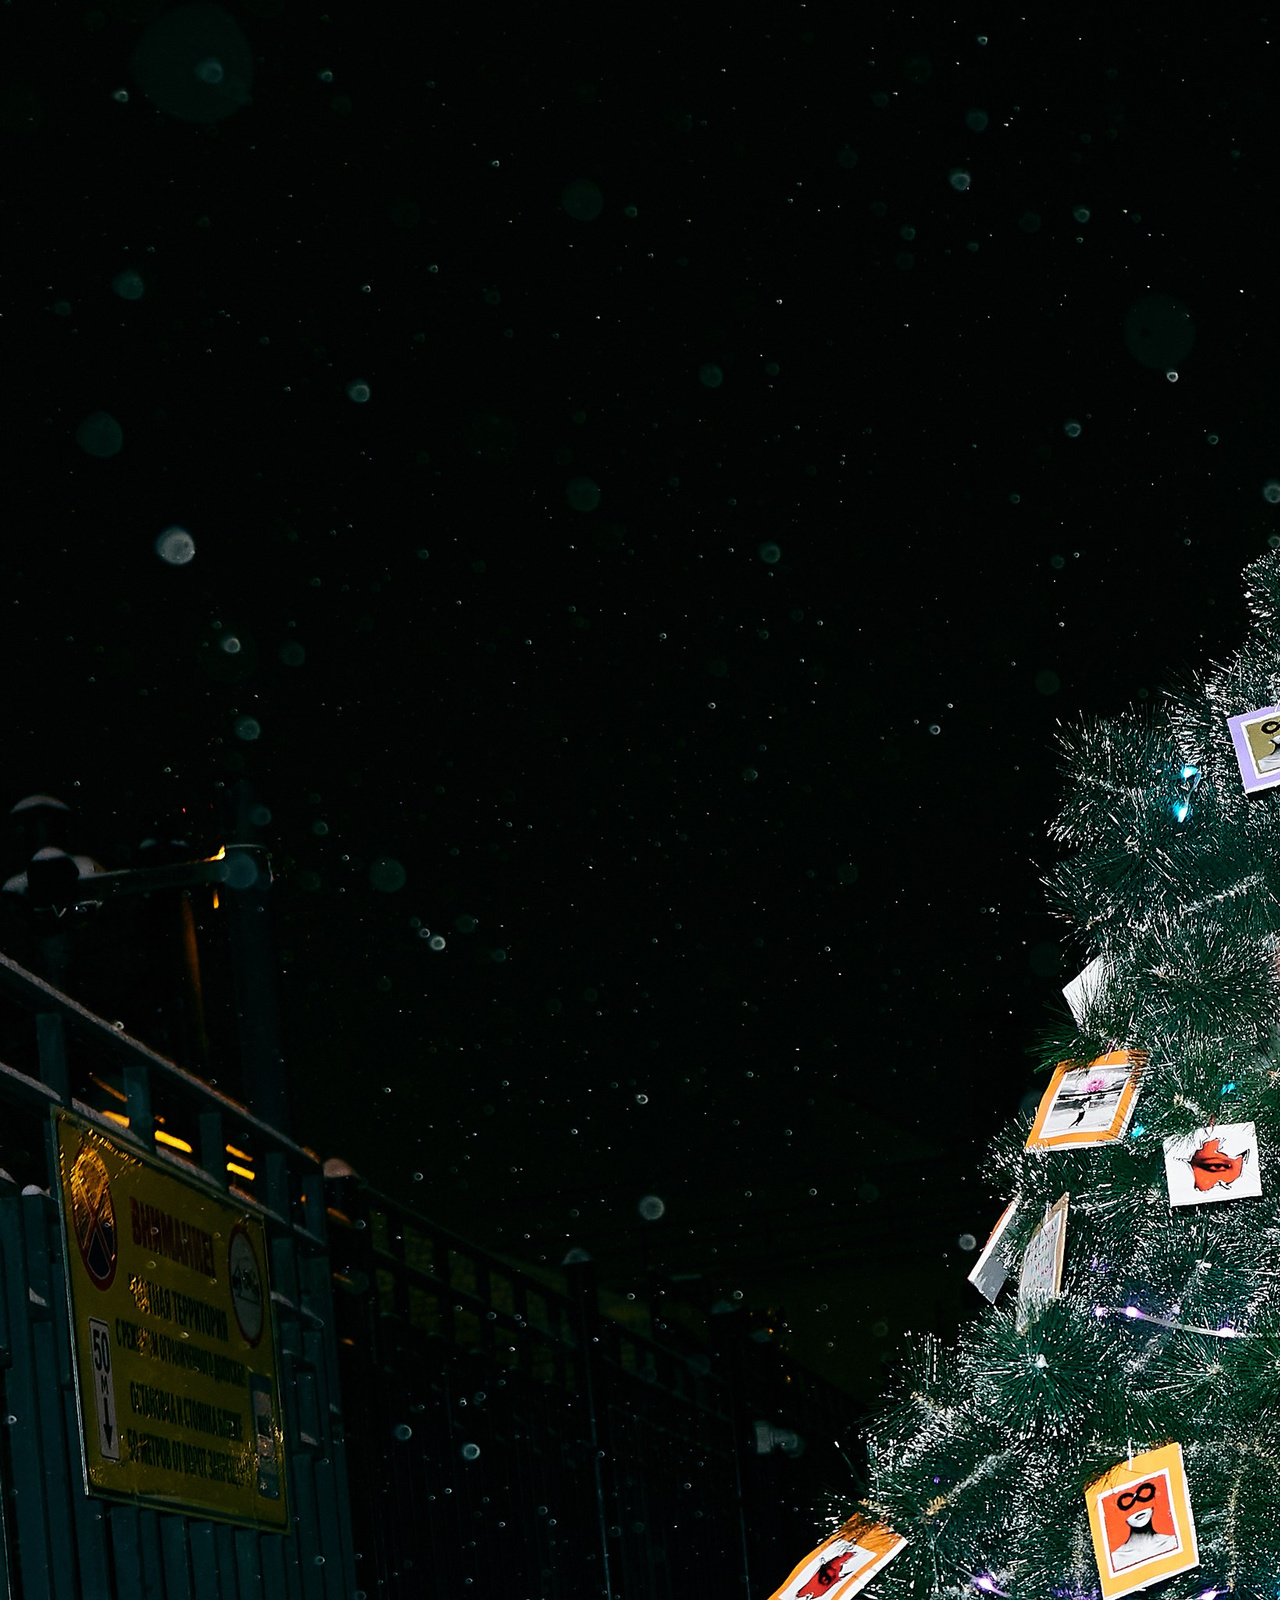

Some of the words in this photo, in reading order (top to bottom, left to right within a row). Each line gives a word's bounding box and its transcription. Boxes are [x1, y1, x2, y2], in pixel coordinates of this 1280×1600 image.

[129, 1196, 216, 1278] ВНИМАНИЕ!
[127, 1271, 171, 1321] ТНАЯ
[170, 1289, 228, 1342] ТЕРРИТОРИЯ
[92, 1328, 111, 1374] 50
[120, 1319, 159, 1359] РЕЖМ
[207, 1449, 253, 1490] ЗАПРЕЩ
